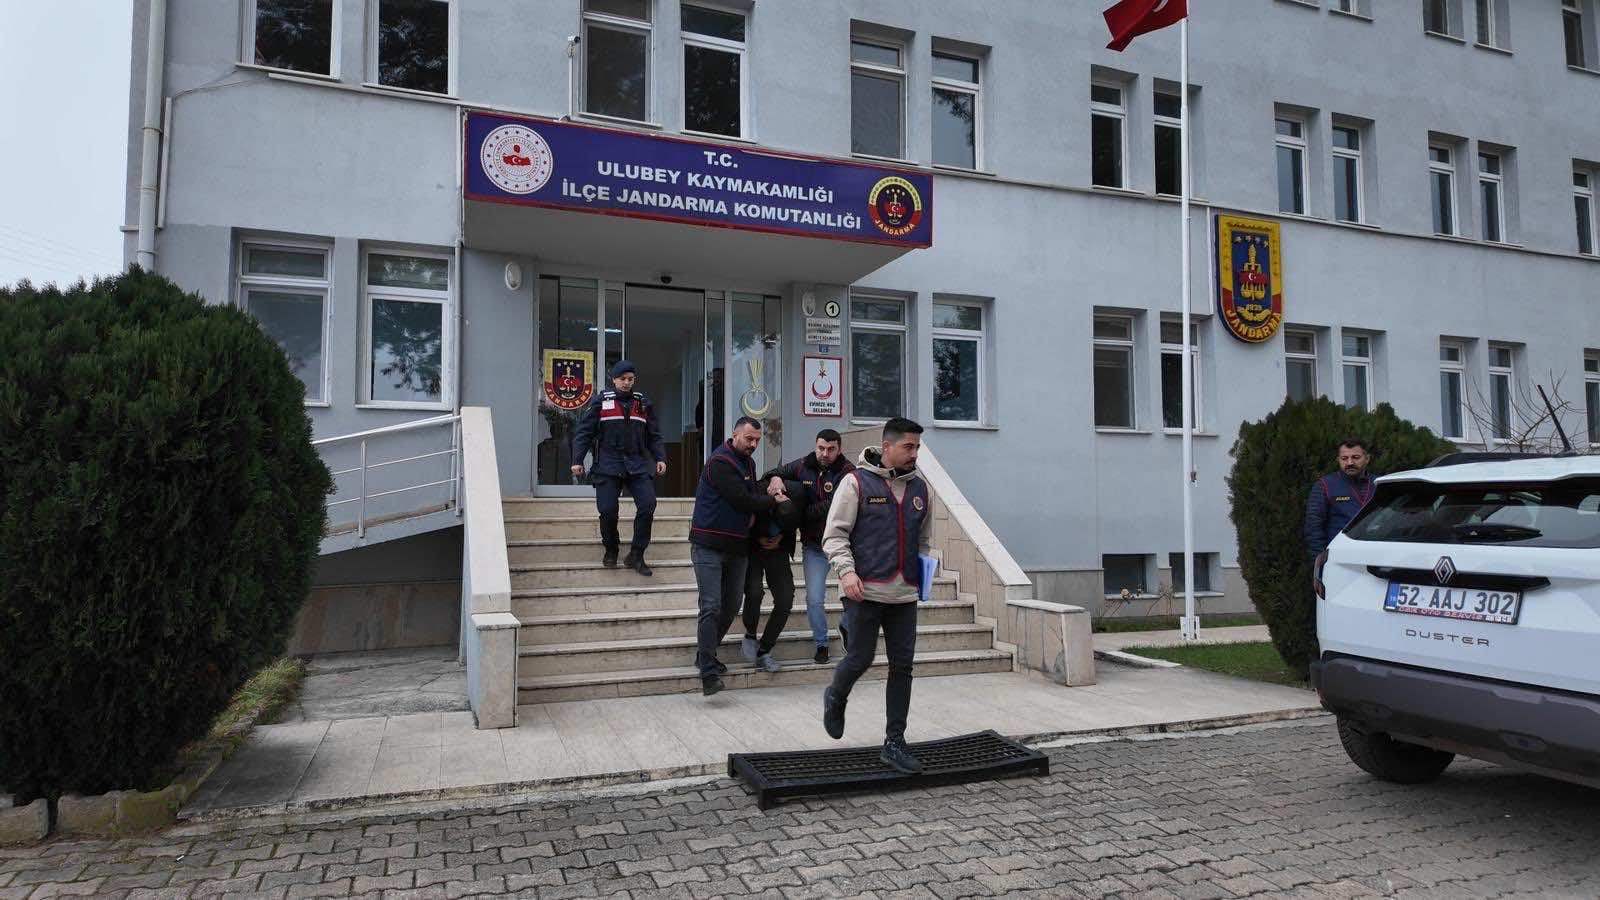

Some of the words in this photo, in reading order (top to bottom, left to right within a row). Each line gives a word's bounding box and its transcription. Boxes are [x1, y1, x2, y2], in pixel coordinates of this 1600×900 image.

[704, 151, 738, 168] T.C.
[597, 161, 681, 184] ULUBEY
[687, 172, 833, 204] KAYMAKAMLIĞI
[562, 178, 610, 202] İLÇE
[617, 188, 728, 215] JANDARMA
[734, 202, 861, 230] KOMUTANLIĞI
[874, 219, 915, 235] JANDARMA
[829, 304, 835, 314] 1
[1226, 309, 1281, 338] JANDARMA
[546, 388, 590, 407] JANDARMA
[1398, 586, 1420, 606] 52
[1429, 588, 1466, 610] AAJ
[1474, 592, 1514, 615] 302
[1405, 628, 1490, 647] DUSTER
